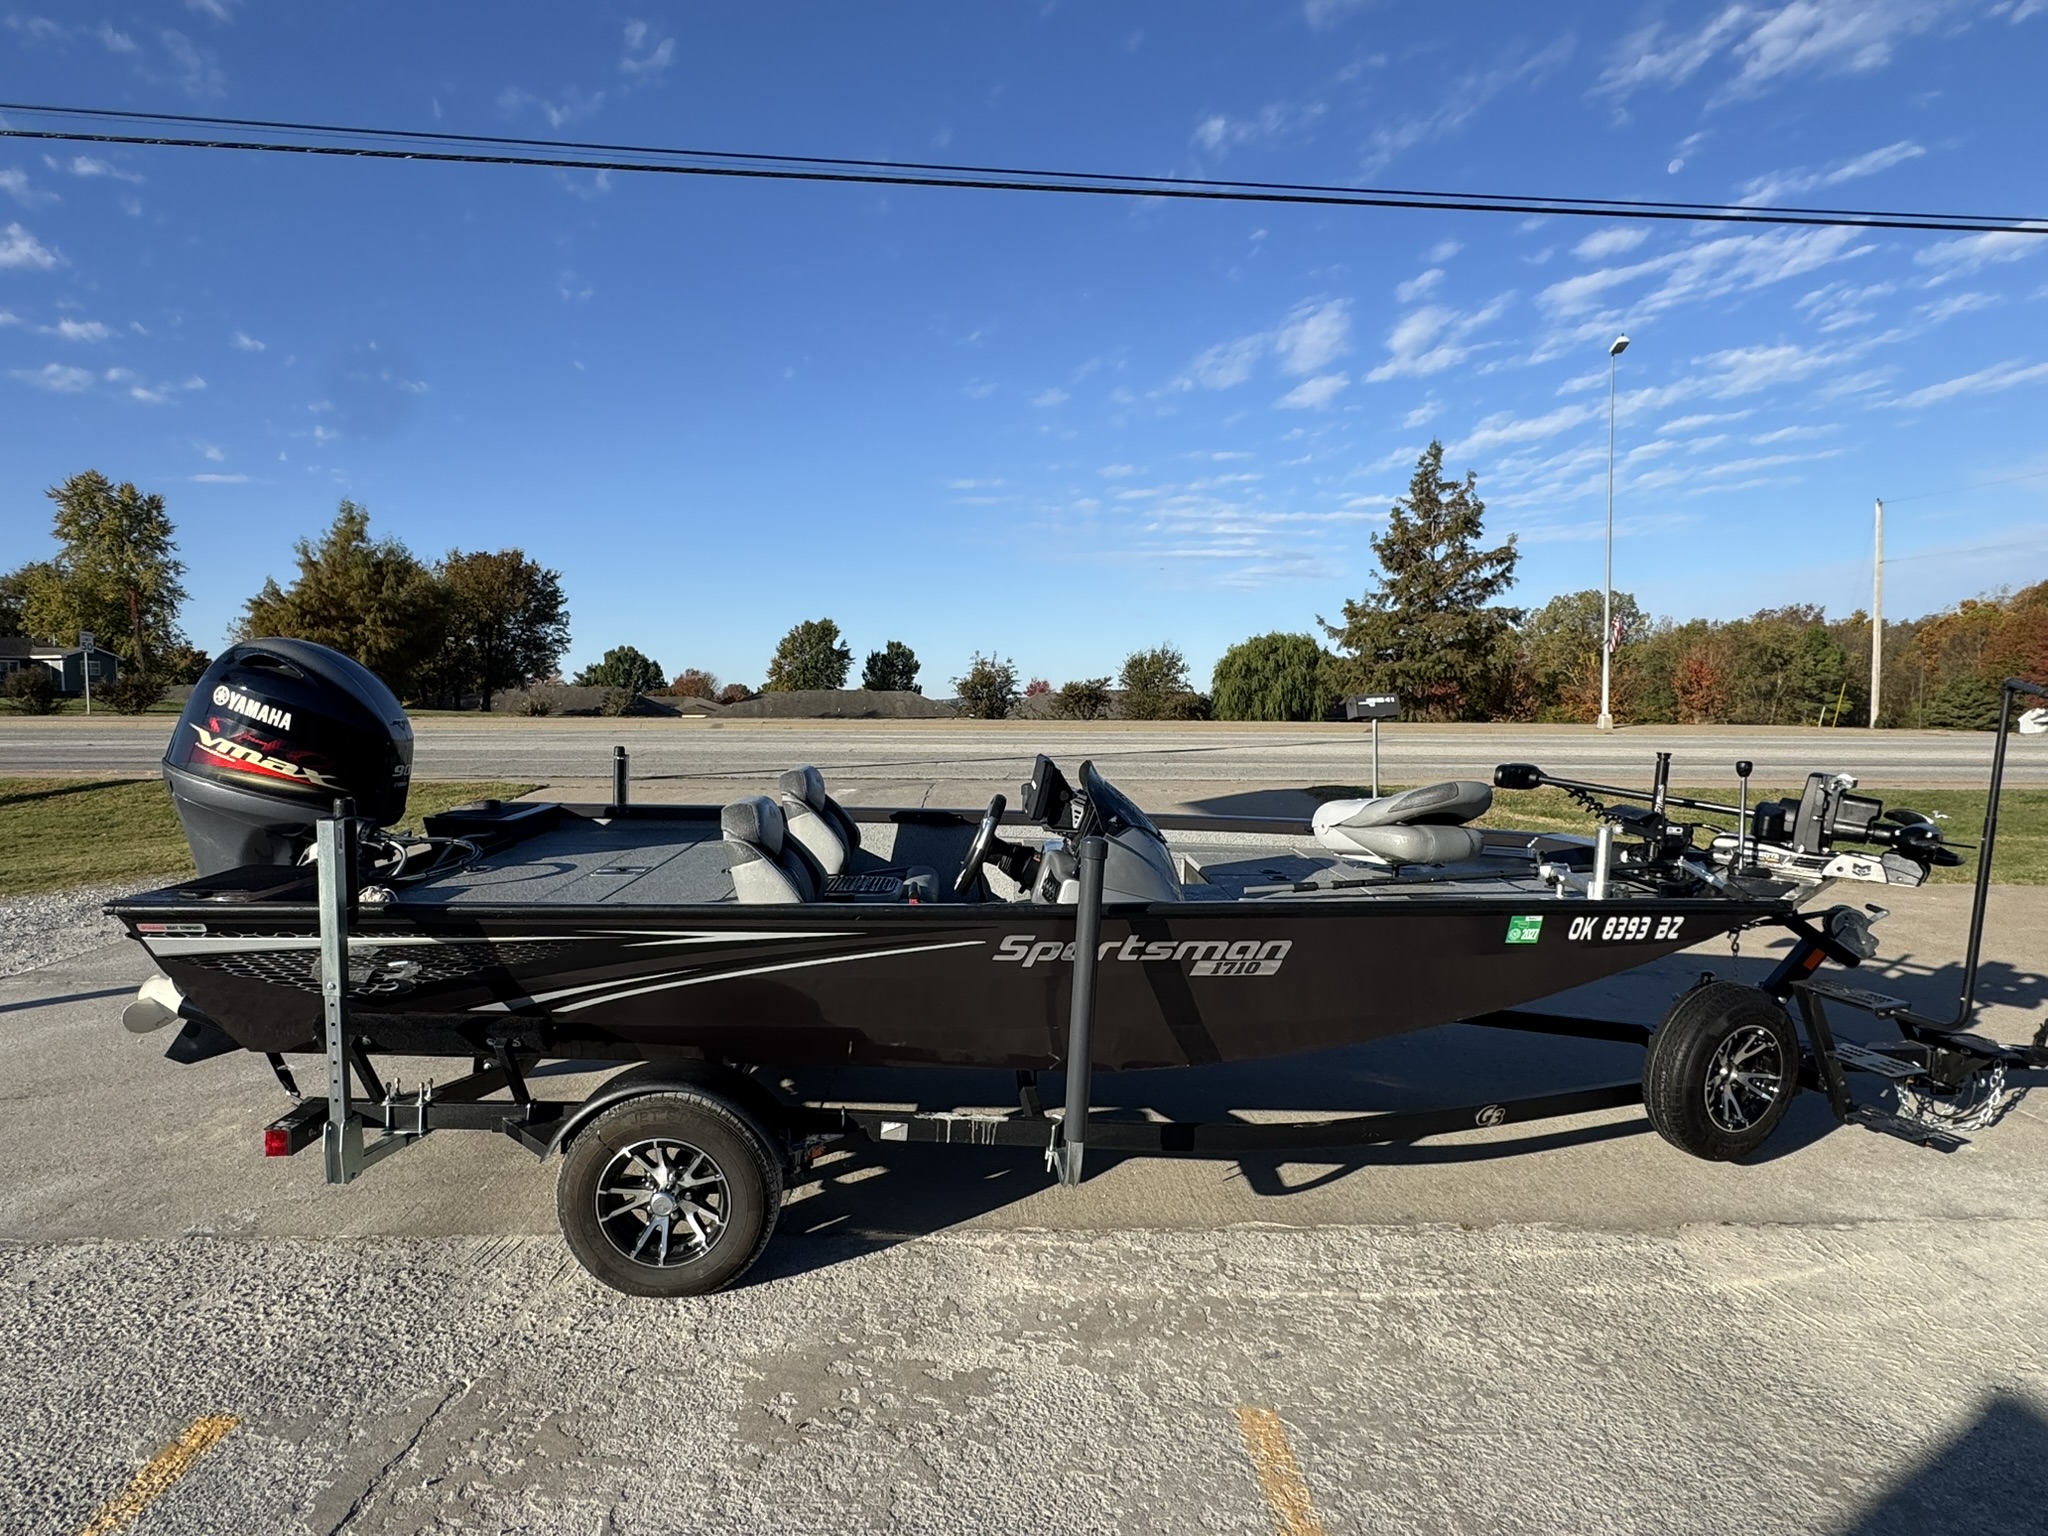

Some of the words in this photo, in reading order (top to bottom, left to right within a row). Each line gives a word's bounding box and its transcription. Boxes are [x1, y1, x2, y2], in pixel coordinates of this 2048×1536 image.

[82, 642, 93, 651] 50
[228, 691, 292, 731] YAMAHA
[392, 764, 412, 777] 90
[1568, 917, 1599, 940] OK
[1602, 916, 1651, 940] 8393
[1654, 916, 1685, 940] BZ
[1210, 961, 1262, 975] 1710
